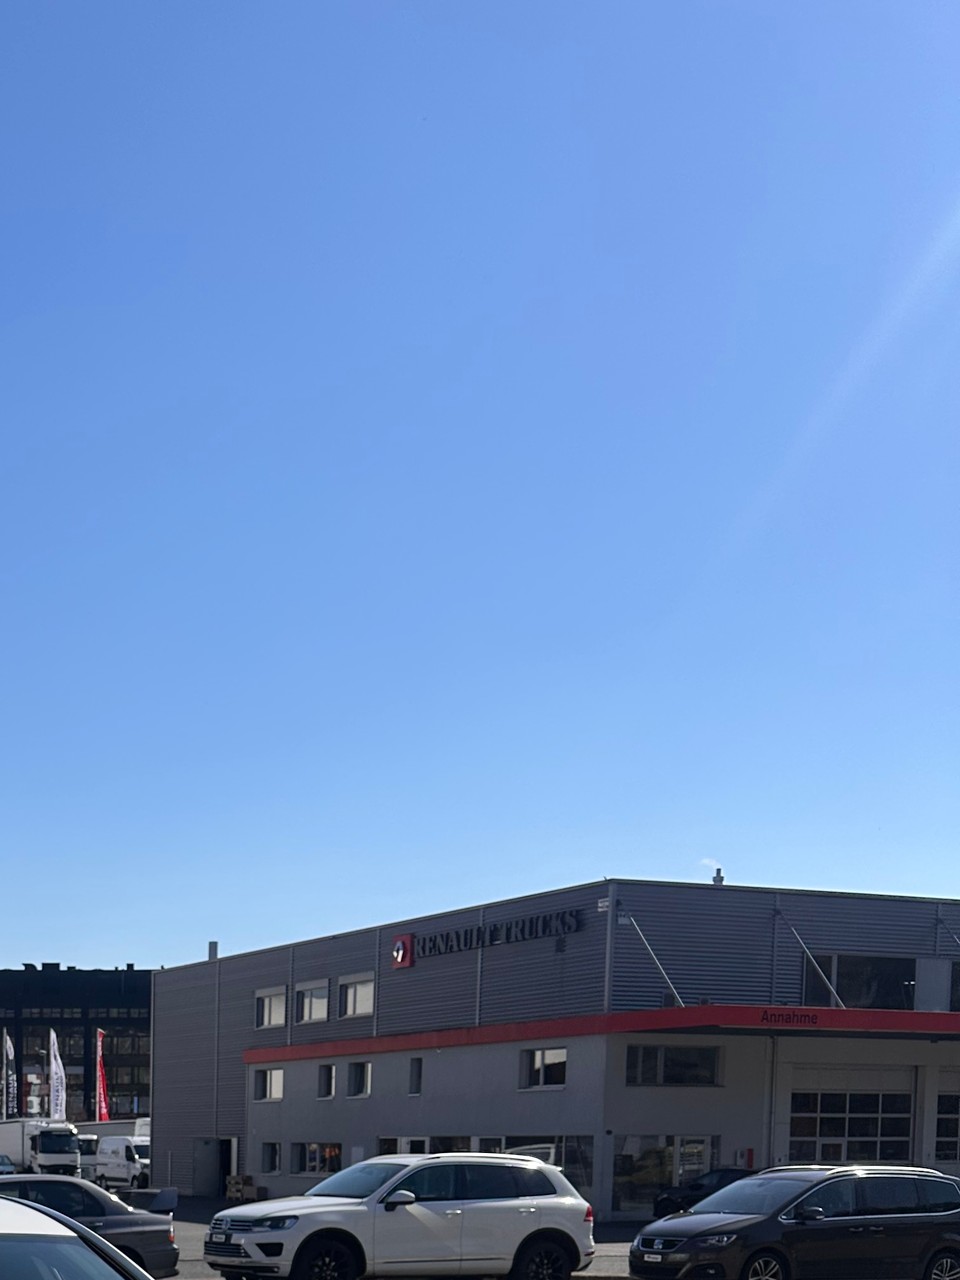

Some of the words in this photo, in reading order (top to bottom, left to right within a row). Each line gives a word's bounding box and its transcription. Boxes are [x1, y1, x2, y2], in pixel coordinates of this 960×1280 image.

[416, 925, 494, 958] RENAULT
[502, 910, 579, 943] TRUCKS
[760, 1009, 818, 1025] Annahme
